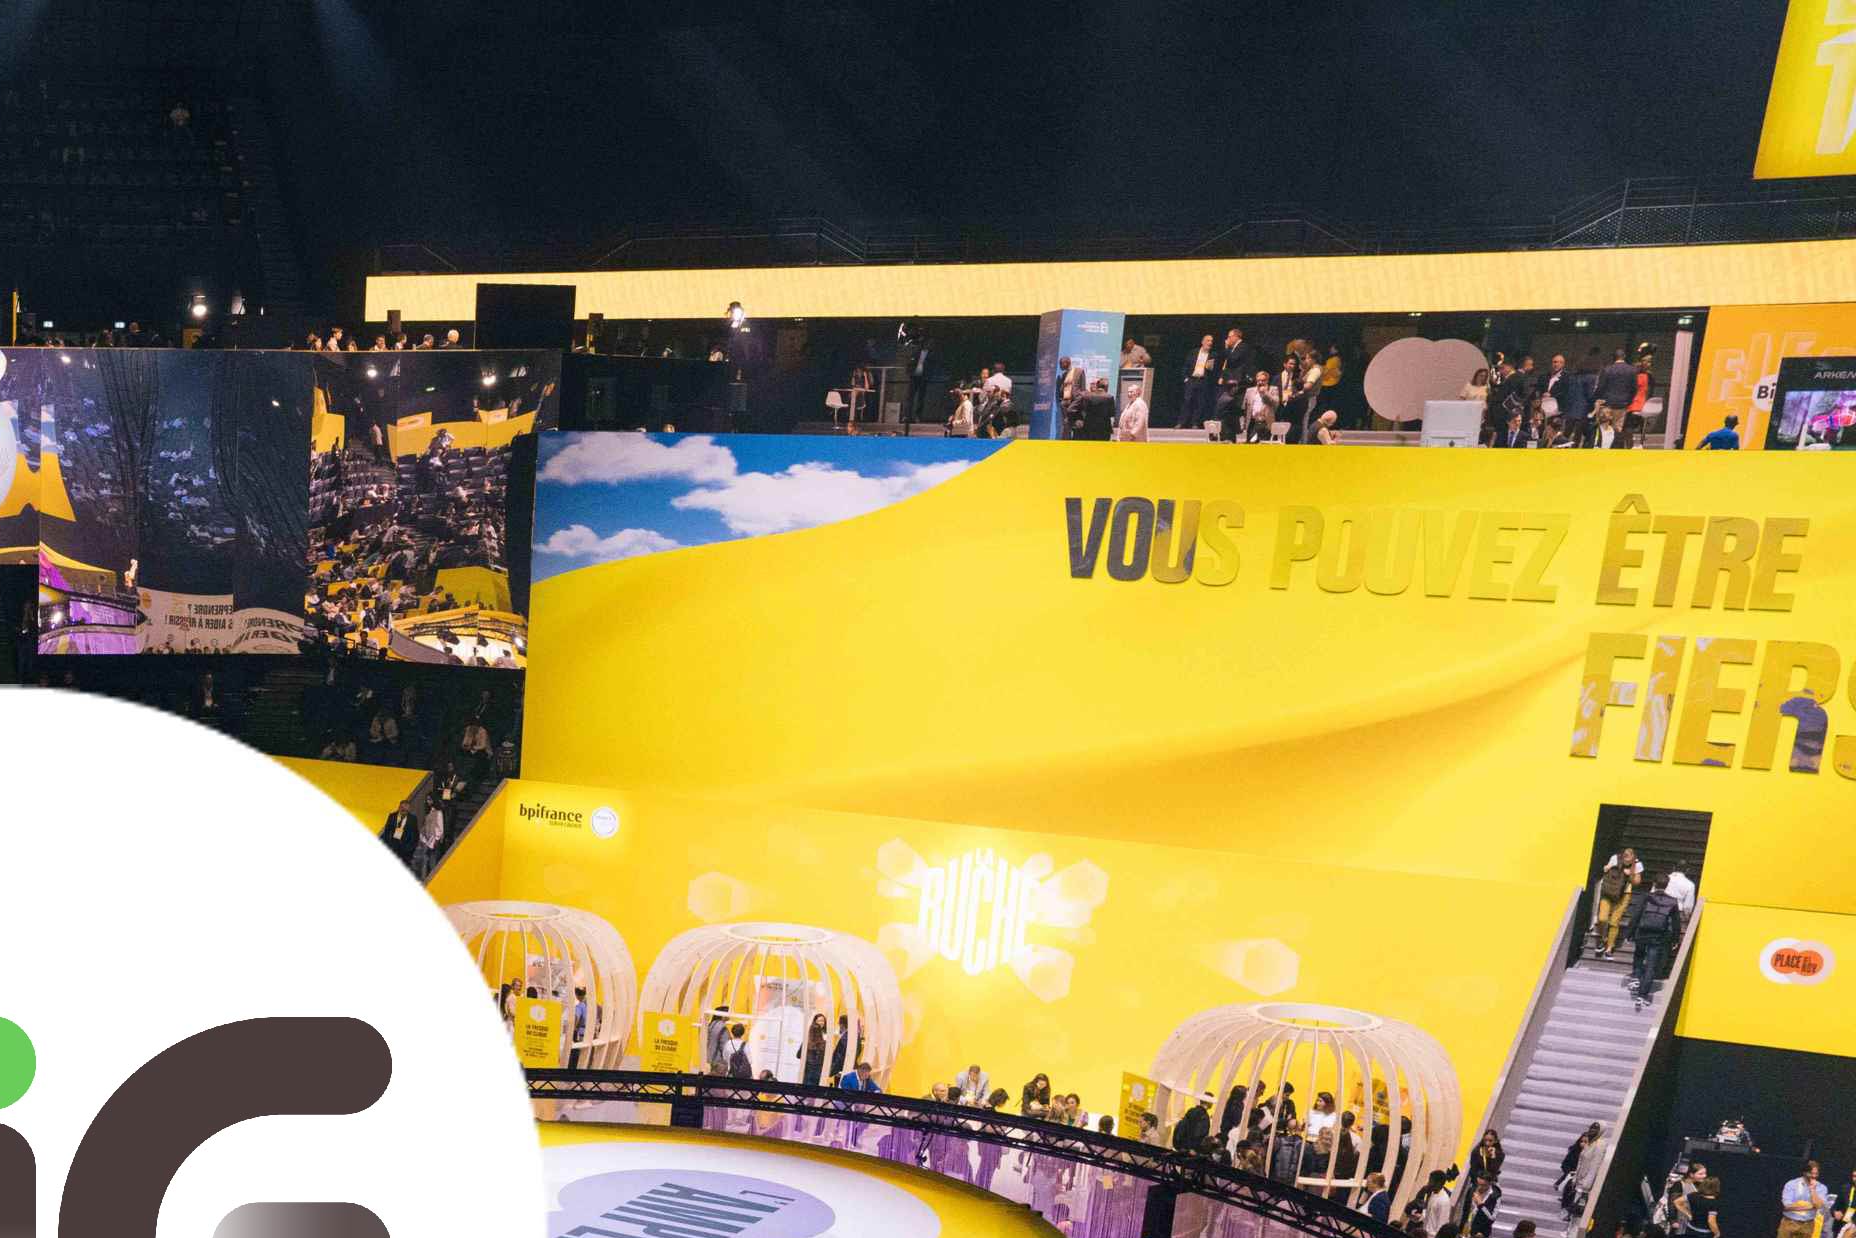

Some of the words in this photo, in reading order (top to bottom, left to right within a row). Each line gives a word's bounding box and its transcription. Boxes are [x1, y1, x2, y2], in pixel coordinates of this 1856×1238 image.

[1757, 383, 1777, 399] Bi
[1065, 496, 1245, 586] VOUS
[1269, 505, 1571, 603] POUVEZ
[1595, 493, 1811, 612] ÊTRE
[519, 803, 582, 822] bpifrance
